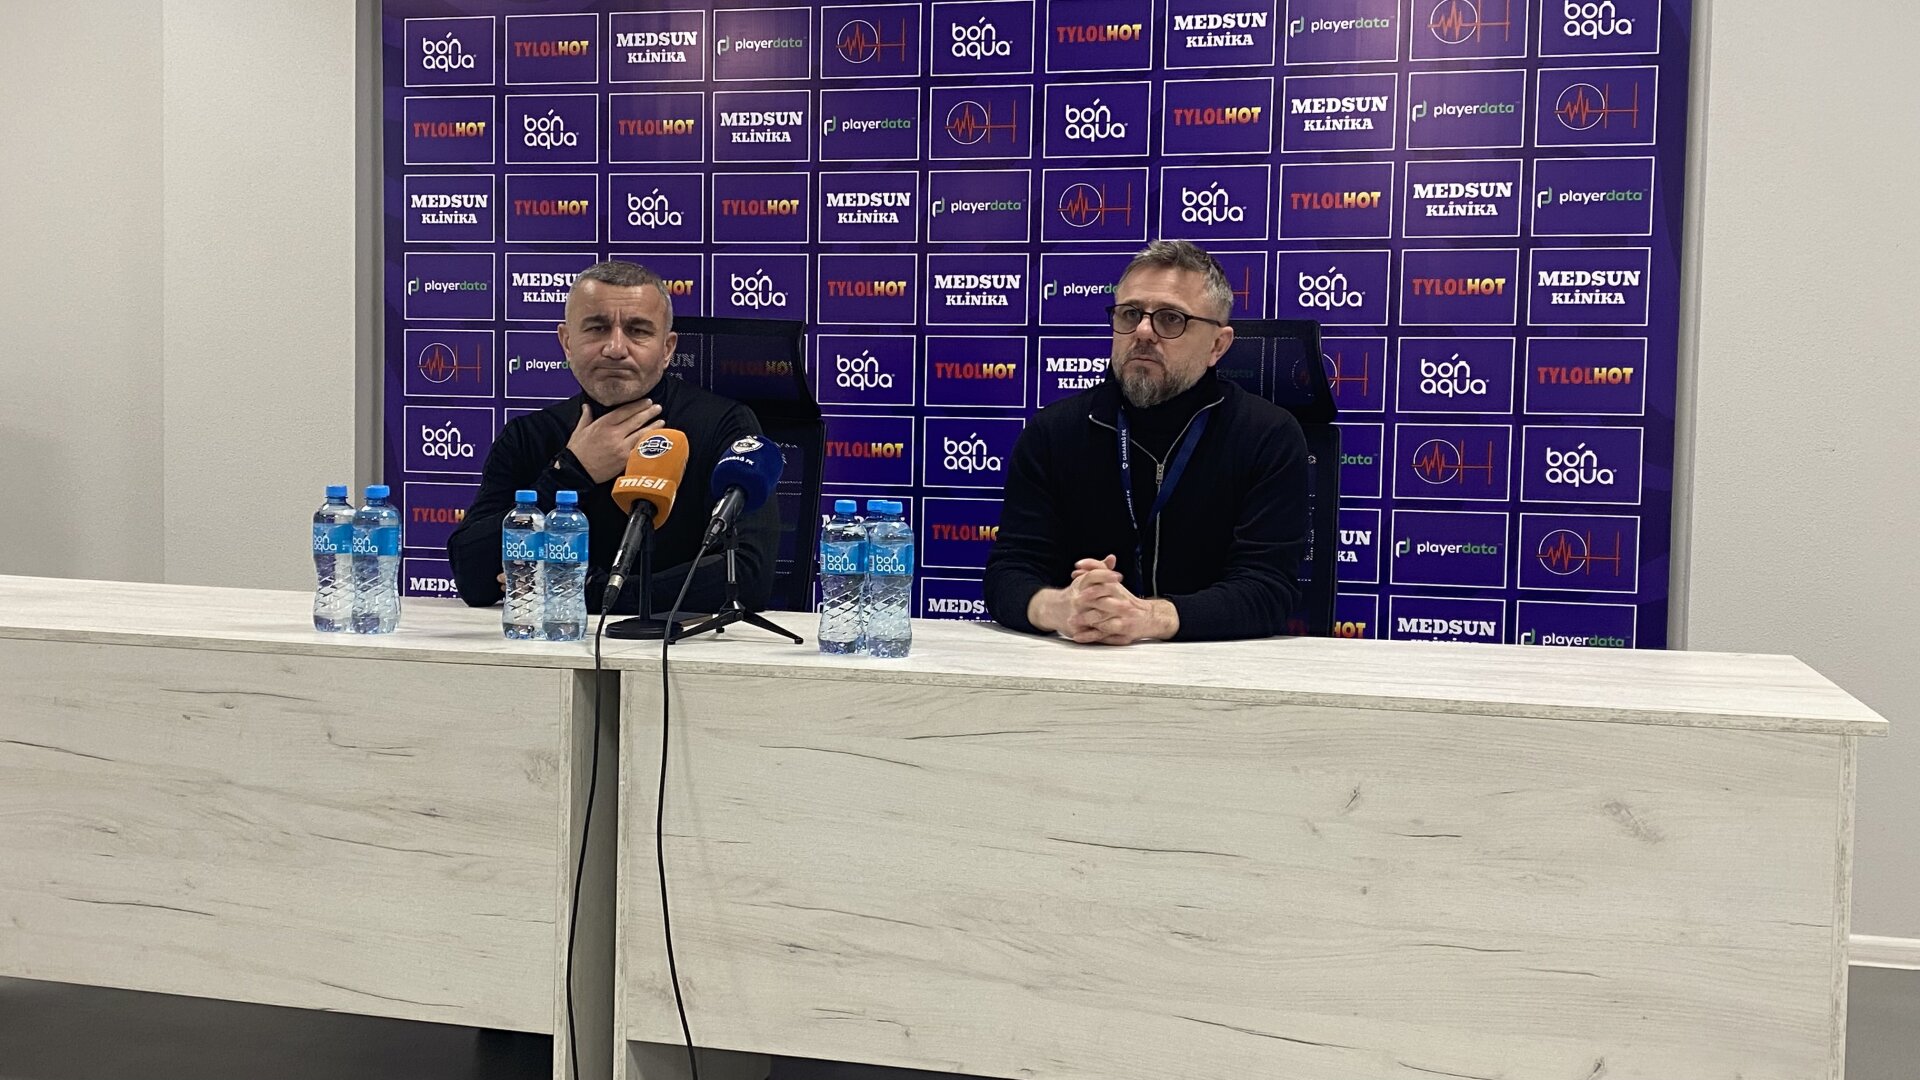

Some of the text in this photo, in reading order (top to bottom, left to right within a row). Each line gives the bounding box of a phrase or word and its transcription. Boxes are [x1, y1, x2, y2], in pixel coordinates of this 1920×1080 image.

[1173, 11, 1267, 31] MEDSUN
[1311, 15, 1390, 33] playerdata
[1564, 18, 1632, 39] aqua
[616, 31, 697, 48] MEDSUN
[1058, 23, 1142, 42] TYLOLHOT
[516, 40, 589, 57] TYLOLHOT
[735, 37, 803, 51] playerdata
[952, 38, 1010, 60] aqua
[423, 52, 474, 72] aqua
[1291, 96, 1388, 114] MEDSUN
[1434, 101, 1514, 118] playerdata
[720, 111, 803, 127] MEDSUN
[1174, 106, 1261, 124] TYLOLHOT
[414, 121, 485, 137] TYLOLHOT
[620, 119, 694, 135] TYLOLHOT
[842, 117, 911, 132] playerdata
[1065, 121, 1126, 142] aqua
[524, 131, 577, 149] aqua
[1413, 181, 1513, 199] MEDSUN
[1559, 188, 1642, 205] playerdata
[411, 194, 488, 208] MEDSUN
[516, 200, 588, 215] TYLOLHOT
[723, 199, 799, 215] TYLOLHOT
[826, 191, 911, 207] MEDSUN
[950, 198, 1021, 214] playerdata
[1292, 191, 1381, 209] TYLOLHOT
[628, 210, 682, 229] aqua
[1182, 204, 1244, 225] aqua
[424, 279, 487, 294] playerdata
[512, 273, 575, 288] MEDSU
[934, 273, 1021, 290] MEDSUN
[1413, 278, 1506, 295] TYLOLHOT
[1538, 270, 1641, 287] MEDSUN
[828, 280, 907, 296] TYLOLHOT
[731, 290, 786, 309] aqua
[1299, 289, 1363, 311] aqua
[936, 362, 1016, 379] TYLOLHOT
[1046, 357, 1110, 373] MEDS
[836, 371, 892, 391] aqua
[1538, 367, 1634, 384] TYLOLHOT
[1420, 376, 1487, 398] aqua
[422, 441, 474, 459] aqua
[944, 453, 1001, 474] aqua
[618, 476, 669, 490] misli
[1546, 466, 1614, 488] aqua
[414, 507, 465, 523] TYLOLH
[506, 550, 535, 559] aqua
[549, 551, 578, 561] aqua
[1417, 541, 1497, 558] playerdata
[827, 563, 857, 572] aqua
[876, 564, 905, 573] aqua
[410, 577, 458, 593] MEDS
[928, 597, 986, 614] MEDS
[1397, 617, 1496, 637] MEDSUN
